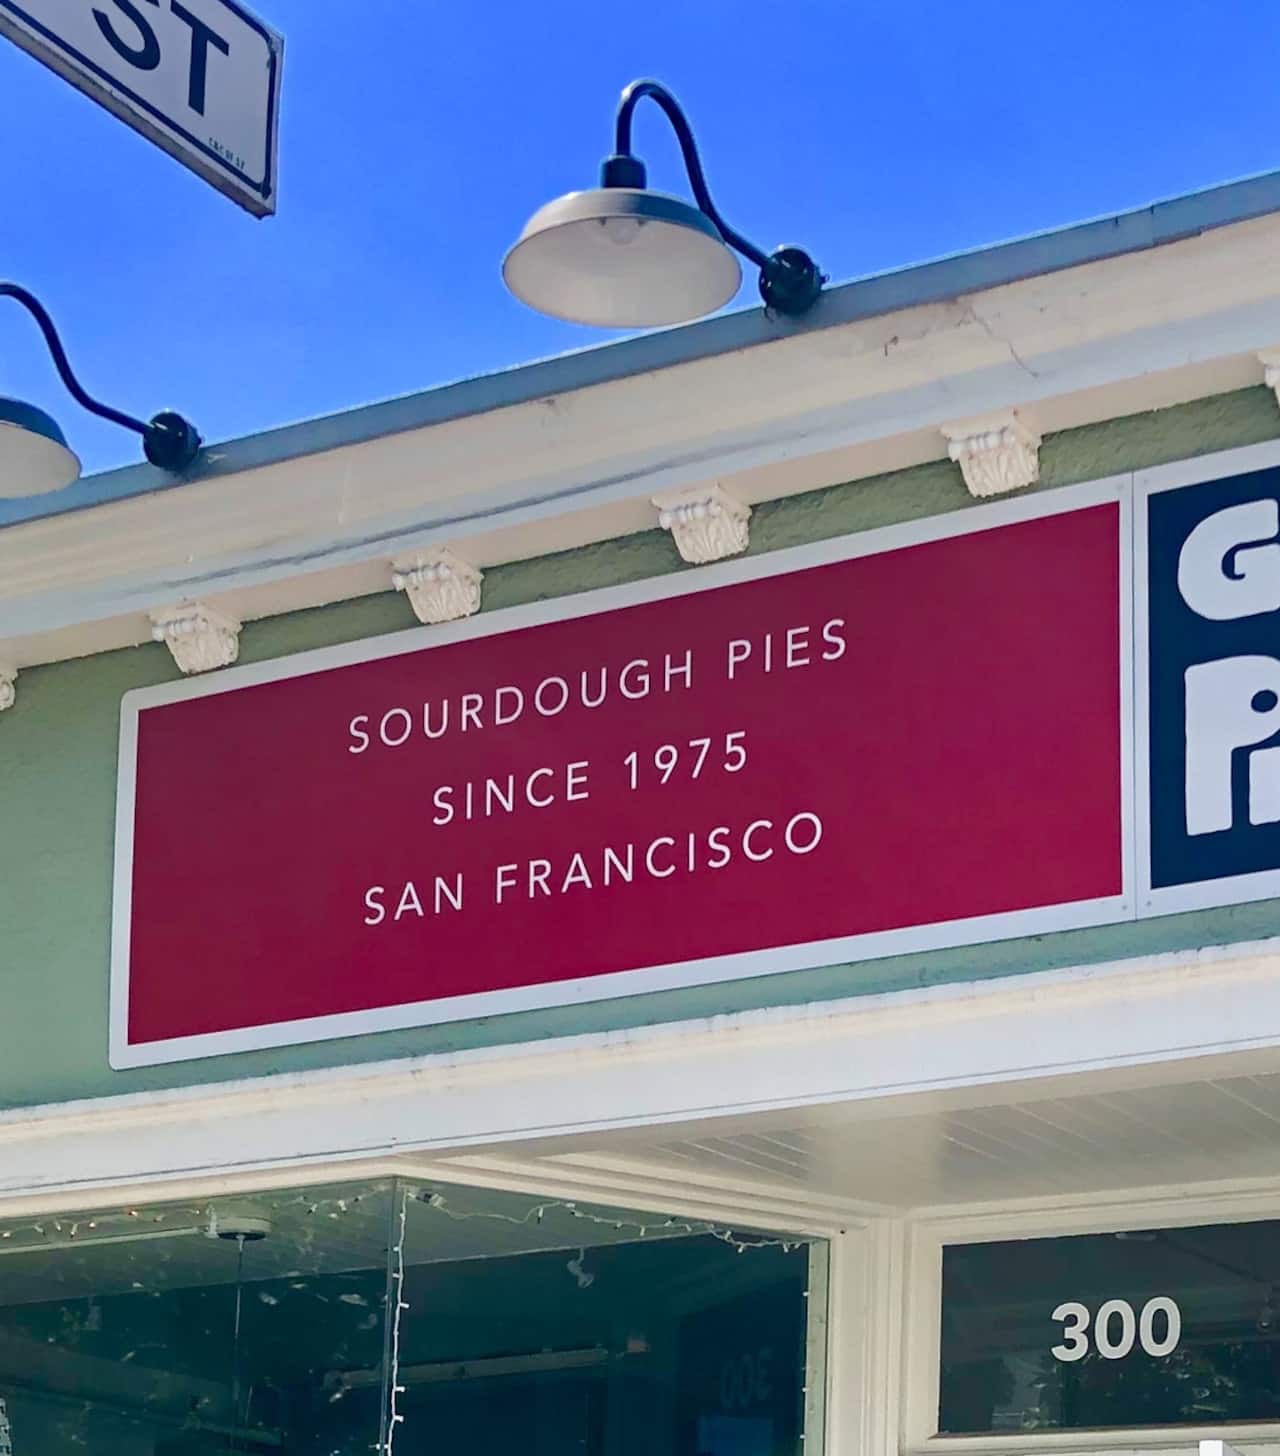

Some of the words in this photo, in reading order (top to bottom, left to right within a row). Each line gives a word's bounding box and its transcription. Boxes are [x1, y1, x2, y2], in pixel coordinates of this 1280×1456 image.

[92, 0, 230, 116] ST
[348, 649, 692, 753] SOURDOUGH
[727, 618, 847, 680] PIES
[432, 760, 590, 826] SINCE
[623, 731, 748, 790] 1975
[363, 872, 464, 926] SAN
[495, 811, 824, 904] FRANCISCO
[1050, 1296, 1182, 1363] 300
